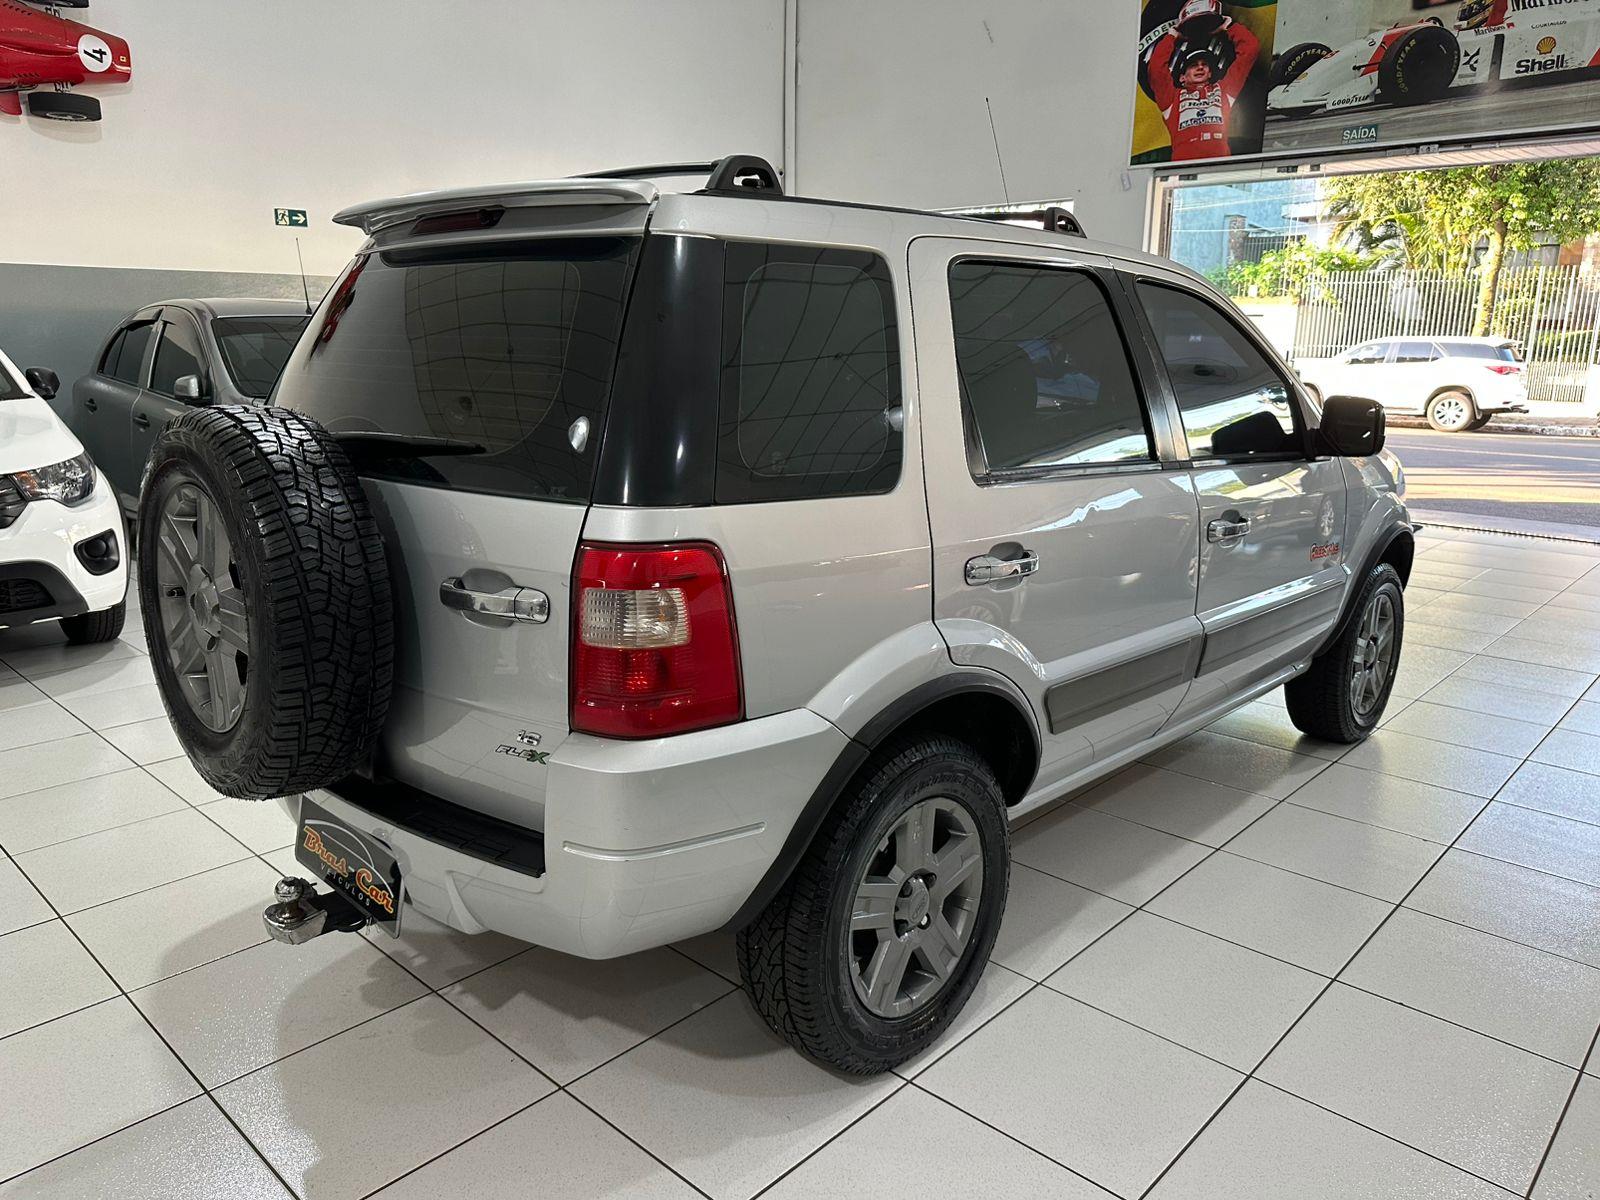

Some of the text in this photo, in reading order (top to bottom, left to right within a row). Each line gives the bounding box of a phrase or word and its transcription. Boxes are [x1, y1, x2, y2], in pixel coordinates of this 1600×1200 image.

[83, 48, 108, 64] 4
[1515, 53, 1566, 75] Shell
[1343, 126, 1377, 140] SAÍDA
[495, 744, 551, 766] FLEX
[355, 868, 395, 914] Car
